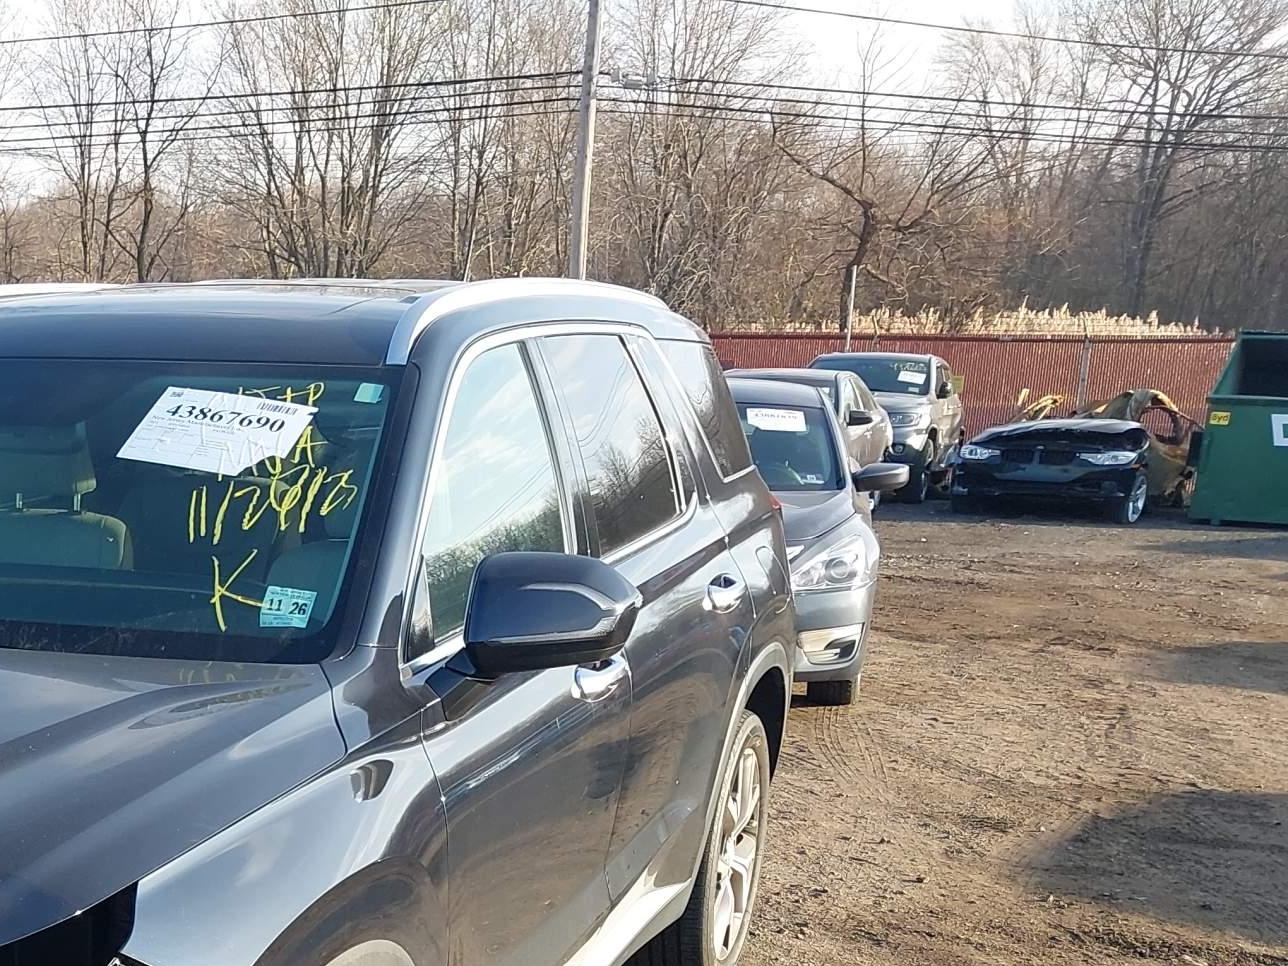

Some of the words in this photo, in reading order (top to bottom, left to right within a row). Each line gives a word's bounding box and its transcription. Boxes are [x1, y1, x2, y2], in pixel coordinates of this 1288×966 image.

[166, 403, 285, 432] 43867690
[210, 548, 269, 632] K
[266, 598, 283, 611] 11
[288, 602, 308, 615] 26
